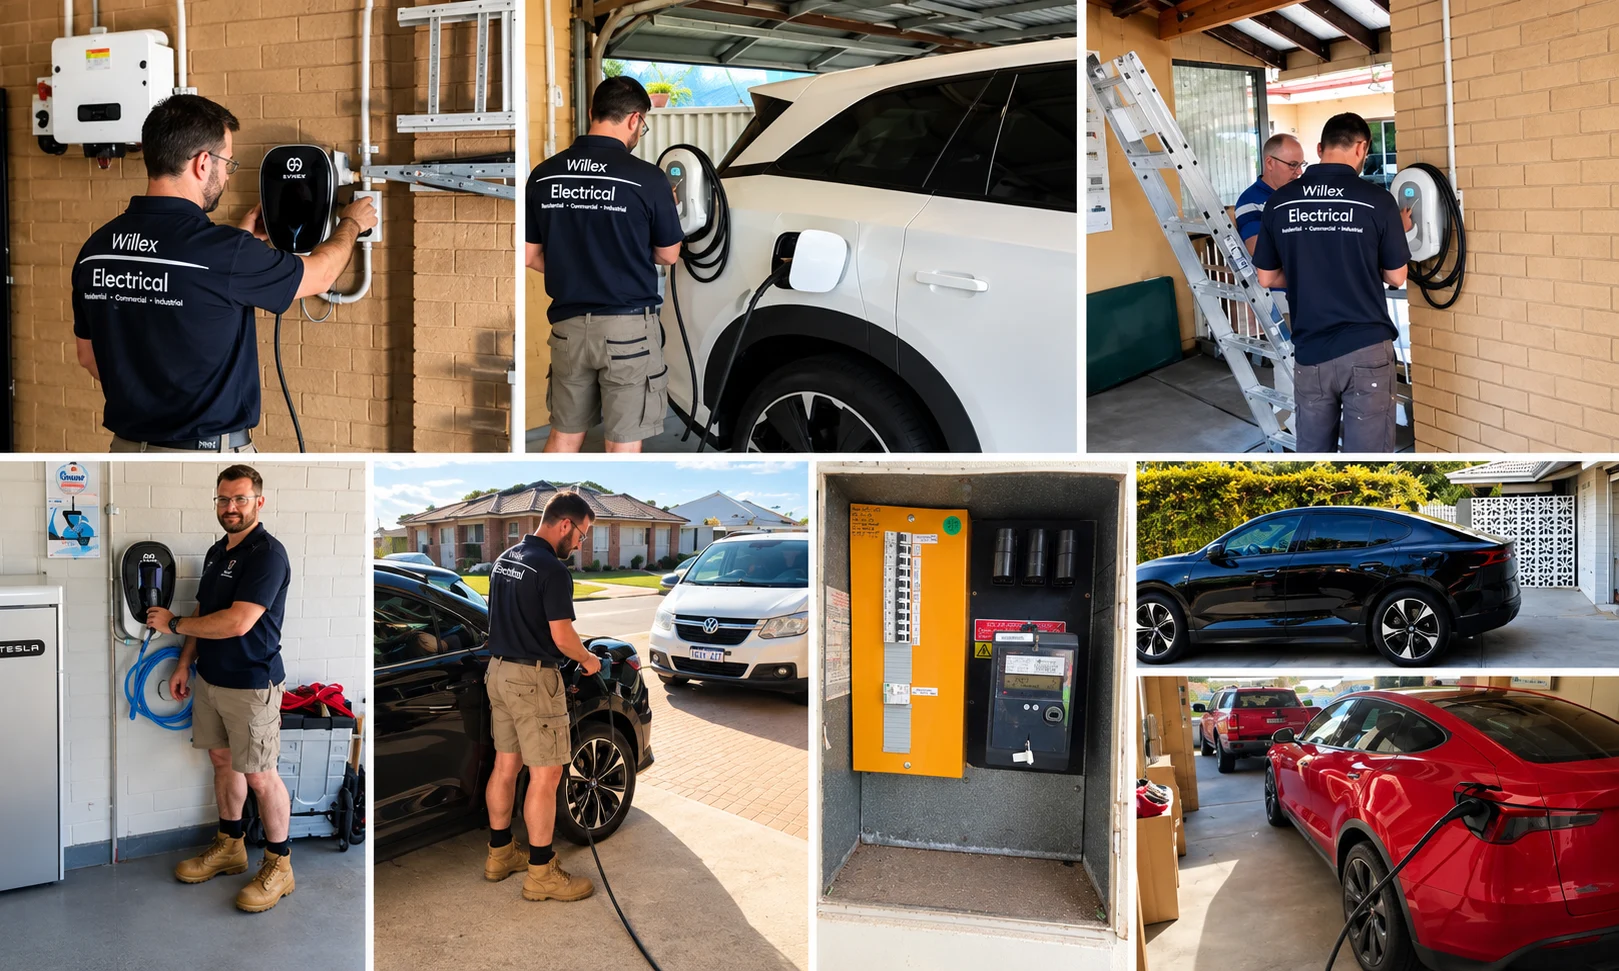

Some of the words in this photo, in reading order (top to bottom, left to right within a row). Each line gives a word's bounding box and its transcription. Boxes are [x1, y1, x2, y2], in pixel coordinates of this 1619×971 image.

[567, 158, 608, 173] Willex
[551, 184, 616, 201] Electrical
[1302, 184, 1345, 197] Willex
[1288, 208, 1354, 223] Electrical
[112, 233, 159, 253] Willex
[92, 268, 168, 293] Electrical
[0, 644, 39, 653] TESLA
